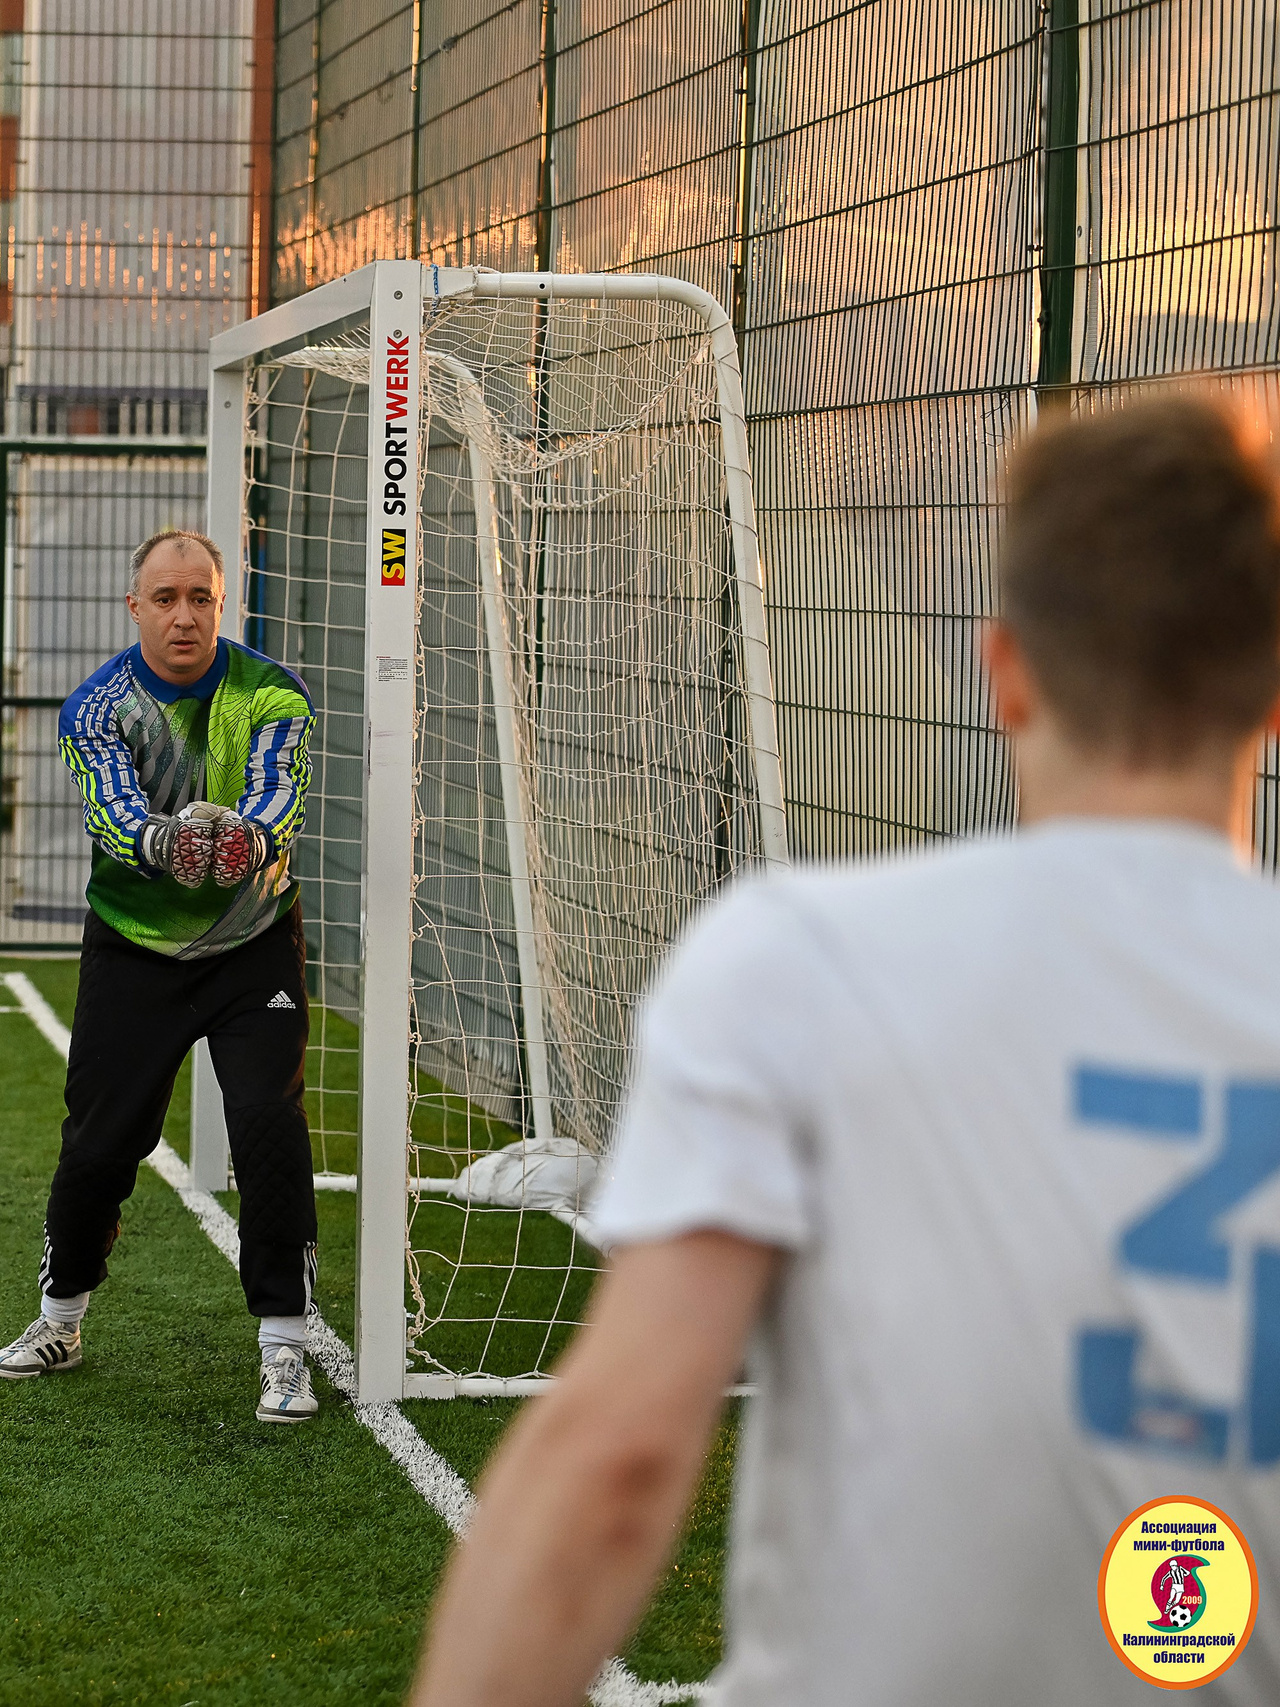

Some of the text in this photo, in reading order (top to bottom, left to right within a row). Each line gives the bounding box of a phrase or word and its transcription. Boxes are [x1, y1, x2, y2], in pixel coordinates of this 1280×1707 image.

[382, 335, 410, 580] SW SPORTWERK
[266, 1001, 297, 1010] adidas
